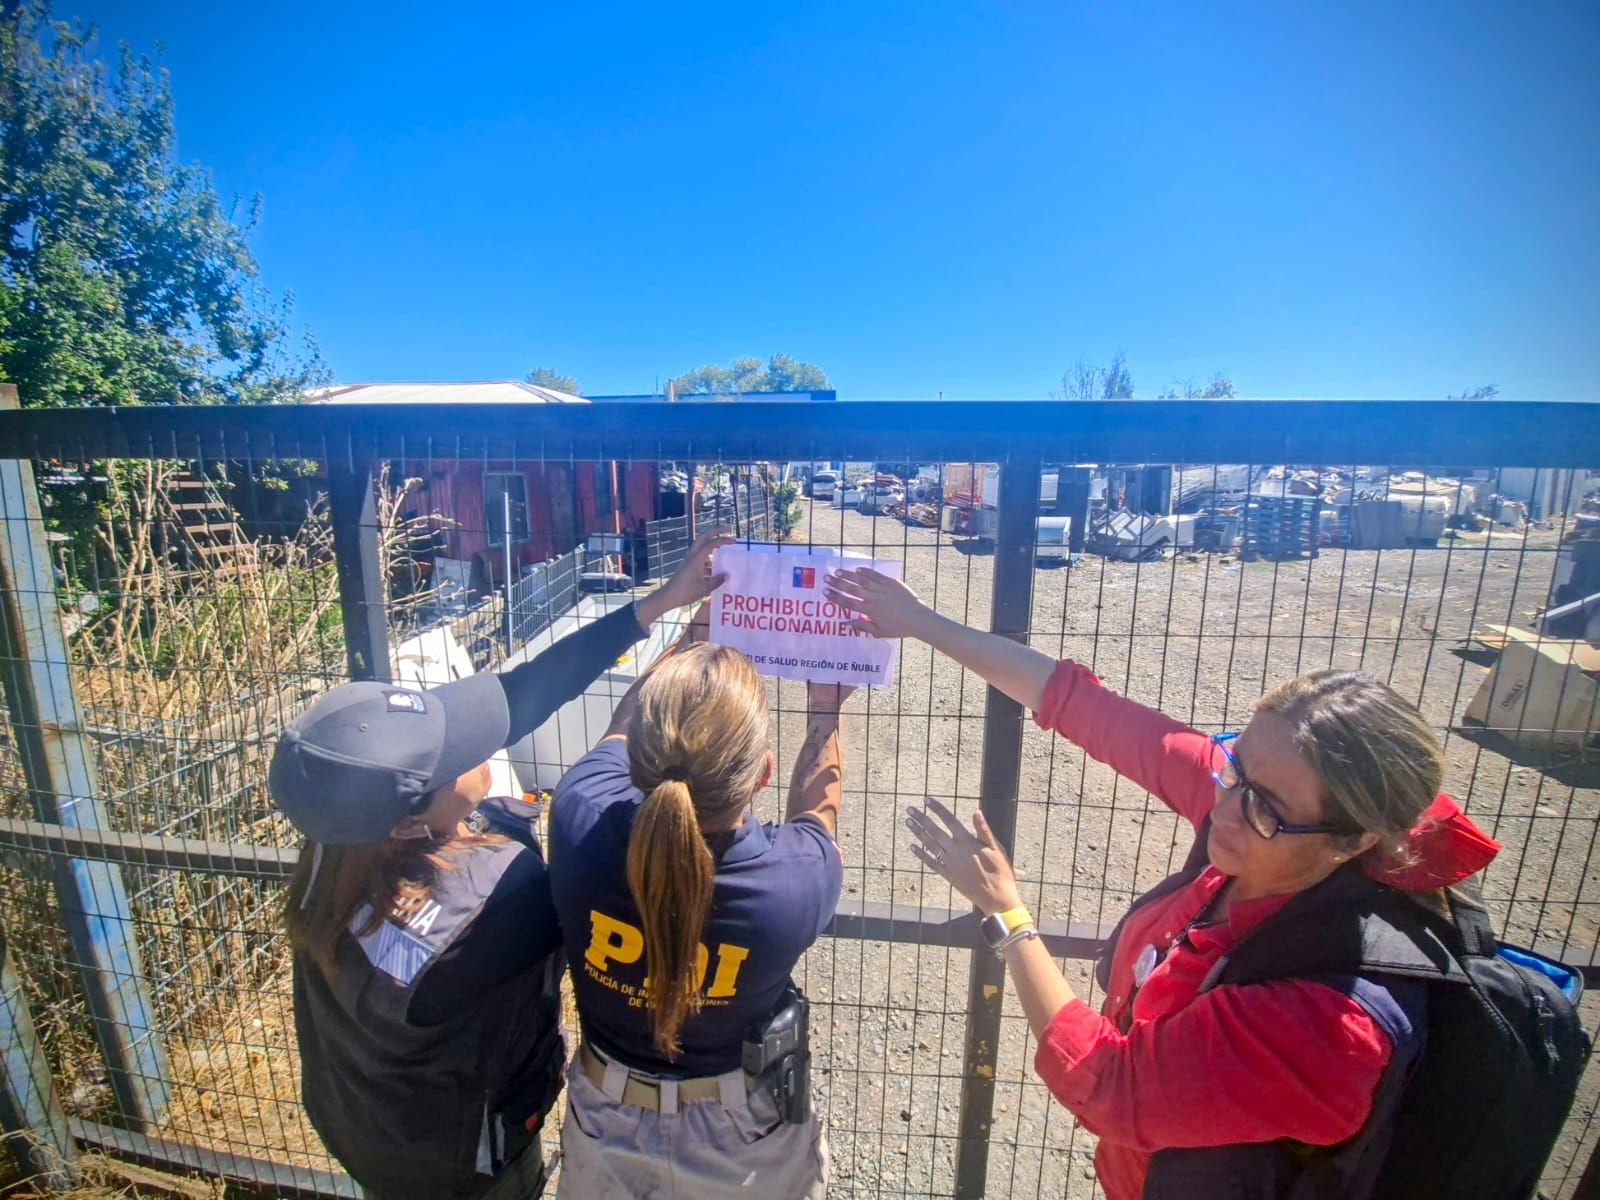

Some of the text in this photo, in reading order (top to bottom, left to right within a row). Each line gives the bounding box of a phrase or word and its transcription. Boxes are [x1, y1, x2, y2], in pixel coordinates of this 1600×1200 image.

[755, 655, 767, 664] DE
[769, 656, 799, 667] SALUD
[800, 658, 835, 670] REGIÓN
[837, 661, 849, 671] DE
[851, 661, 881, 673] ÑUBLE
[621, 984, 636, 995] DE
[628, 996, 643, 1007] DE
